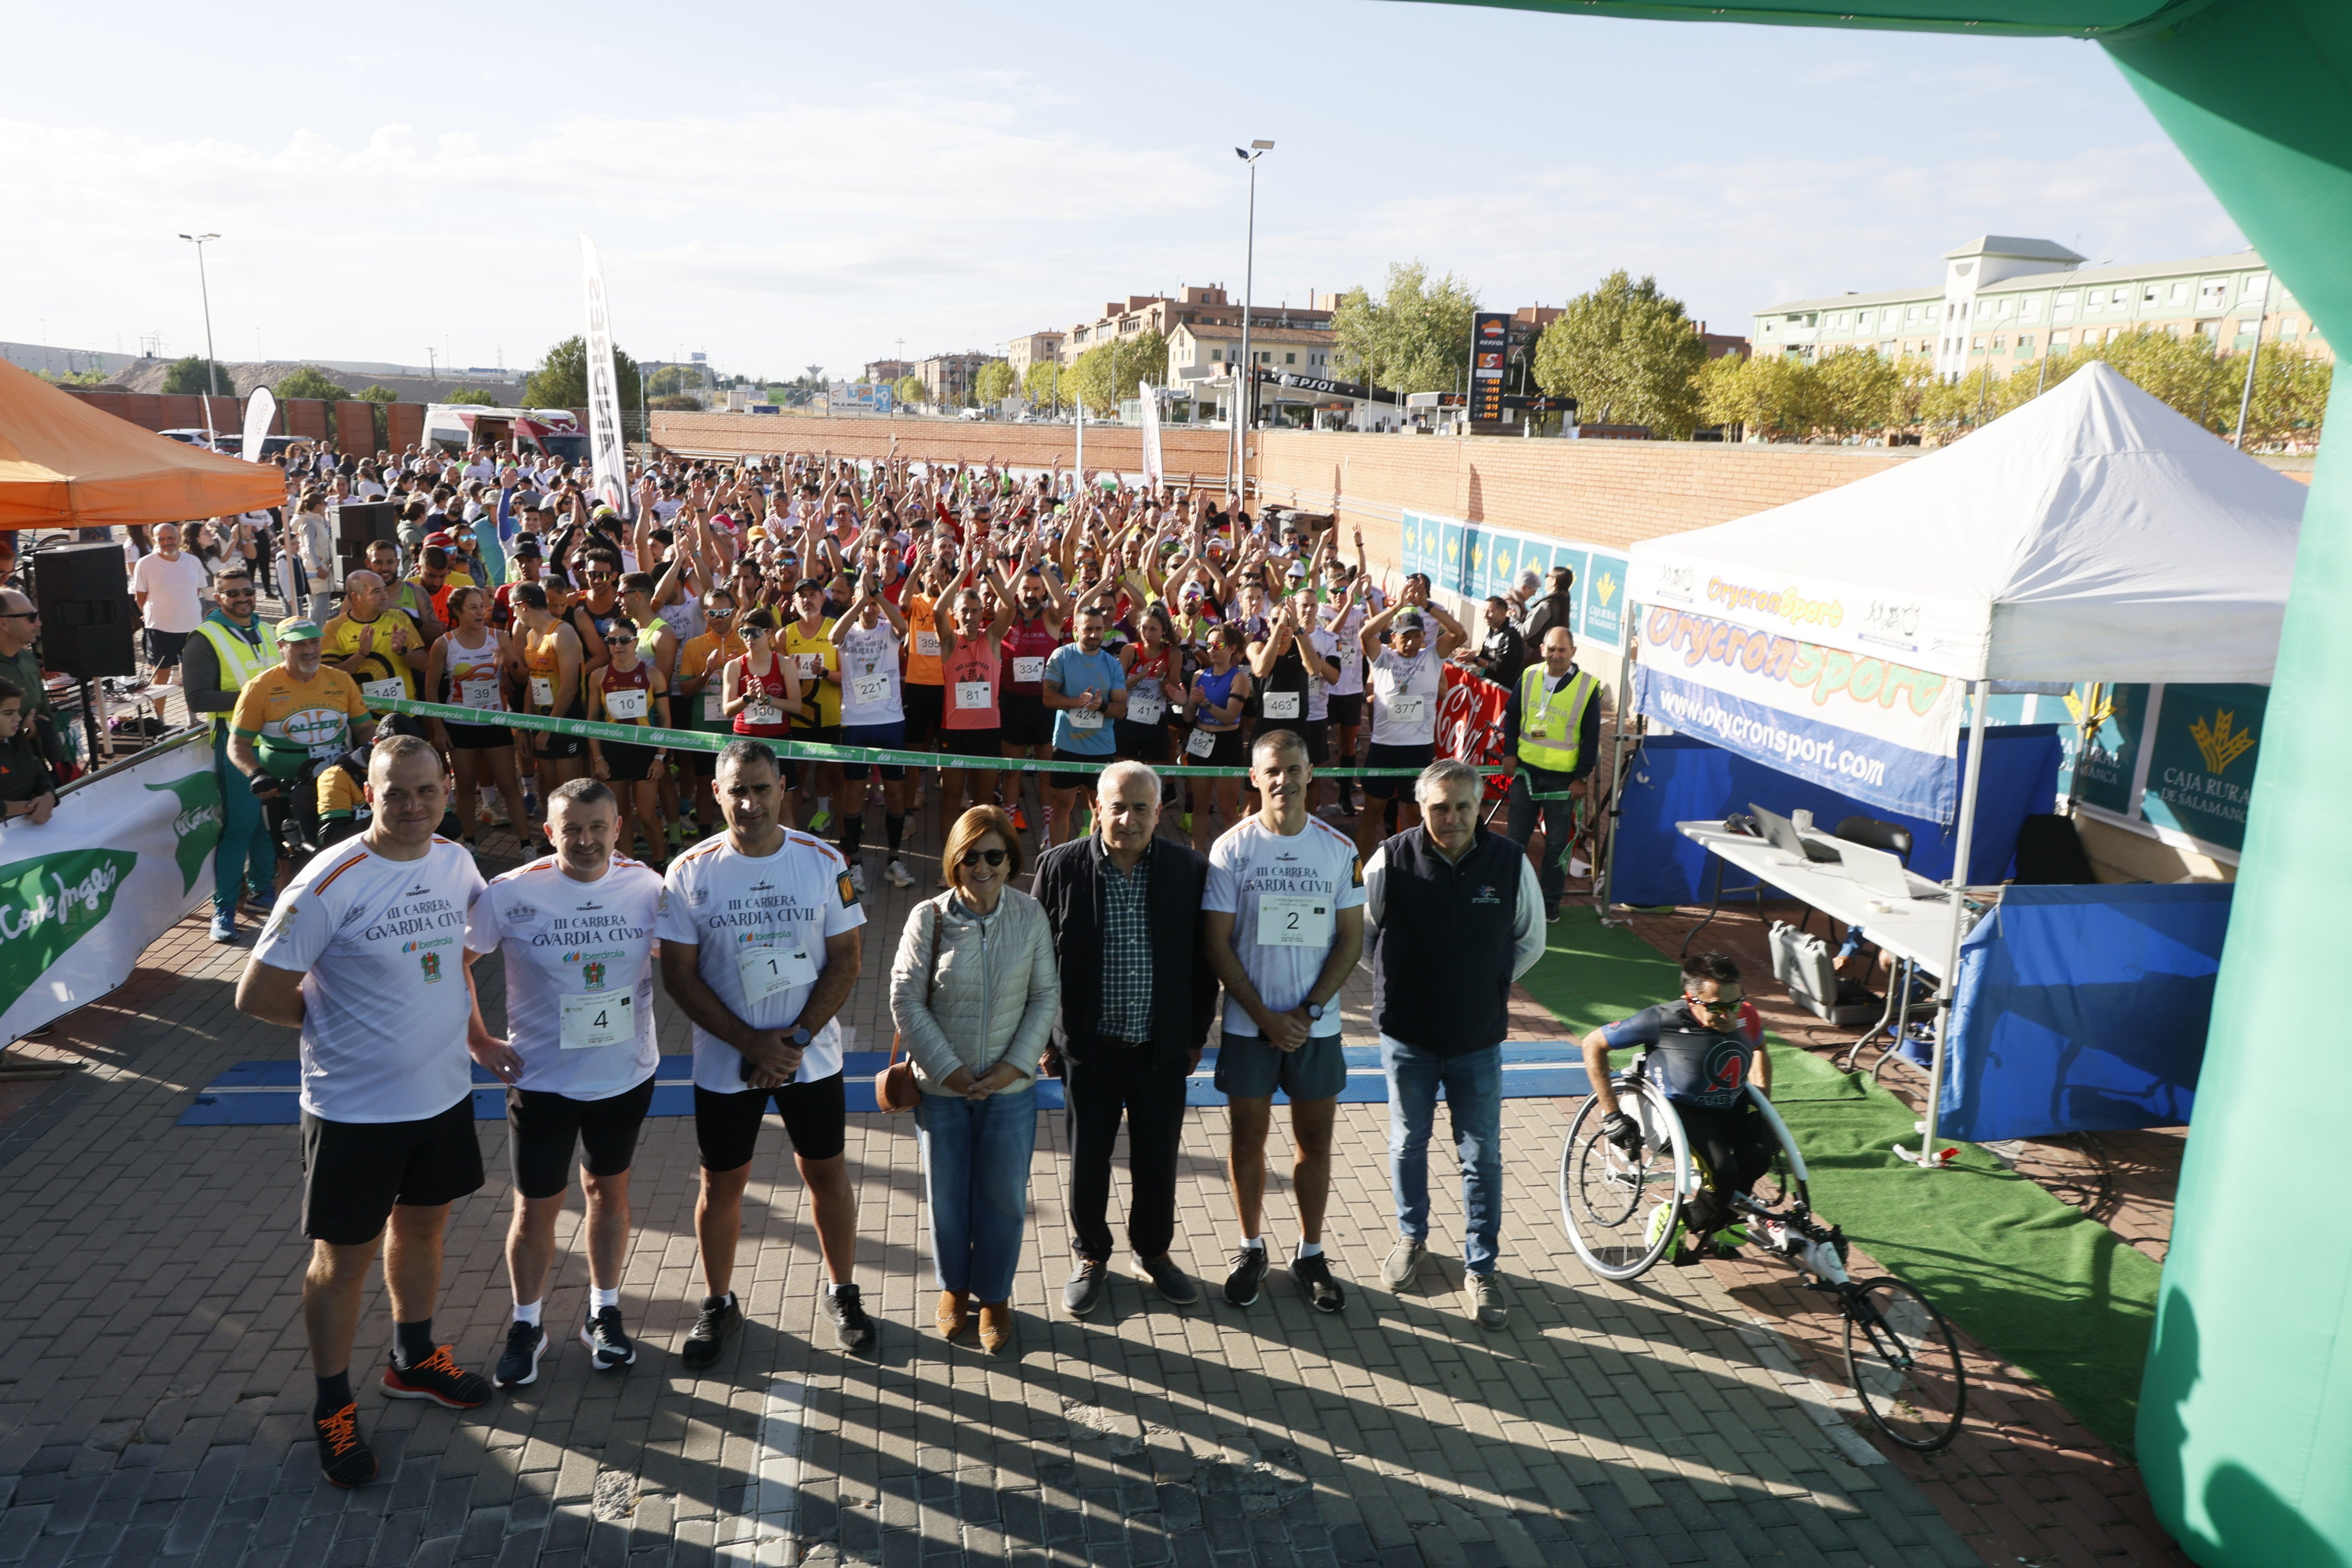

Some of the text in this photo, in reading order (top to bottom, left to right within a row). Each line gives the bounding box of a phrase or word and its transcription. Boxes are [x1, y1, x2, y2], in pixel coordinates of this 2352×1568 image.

[847, 385, 873, 401] lupa
[1601, 609, 1617, 622] RURAL
[921, 638, 940, 648] 395
[1019, 664, 1038, 674] 334
[373, 686, 398, 698] 148
[474, 689, 490, 699] 39
[860, 682, 881, 695] 221
[966, 690, 979, 701] 81
[619, 698, 635, 710] 10
[1271, 700, 1292, 710] 463
[1394, 704, 1417, 714] 377
[426, 708, 464, 720] Iberdrola
[1075, 710, 1097, 720] 424
[1137, 706, 1151, 717] 41
[288, 719, 340, 733] ALCER
[506, 718, 545, 729] Iberdrola
[587, 726, 624, 737] Iberdrola
[1659, 688, 1886, 787] www.orycronsport.com
[666, 735, 701, 745] Iberdrola
[1191, 737, 1208, 750] 482
[2163, 767, 2250, 805] CAJA RURA
[2160, 787, 2248, 824] DE SALAMANC
[1256, 867, 1319, 878] III CARRERA
[1300, 880, 1333, 894] CIVIL
[729, 894, 797, 911] III CARRERA
[387, 899, 452, 920] III CARRERA
[554, 915, 627, 930] III CARRERA
[709, 908, 817, 929] GVARDIA CIVIL
[1286, 912, 1299, 930] 2
[366, 910, 466, 941] GVARDIA CIVIL
[532, 928, 644, 946] GVARDIA CIVIL
[755, 930, 792, 941] Iberdrola
[418, 936, 453, 950] Iberdrola
[582, 949, 625, 961] Iberdrola
[766, 959, 778, 976] 1
[593, 1009, 609, 1029] 4
